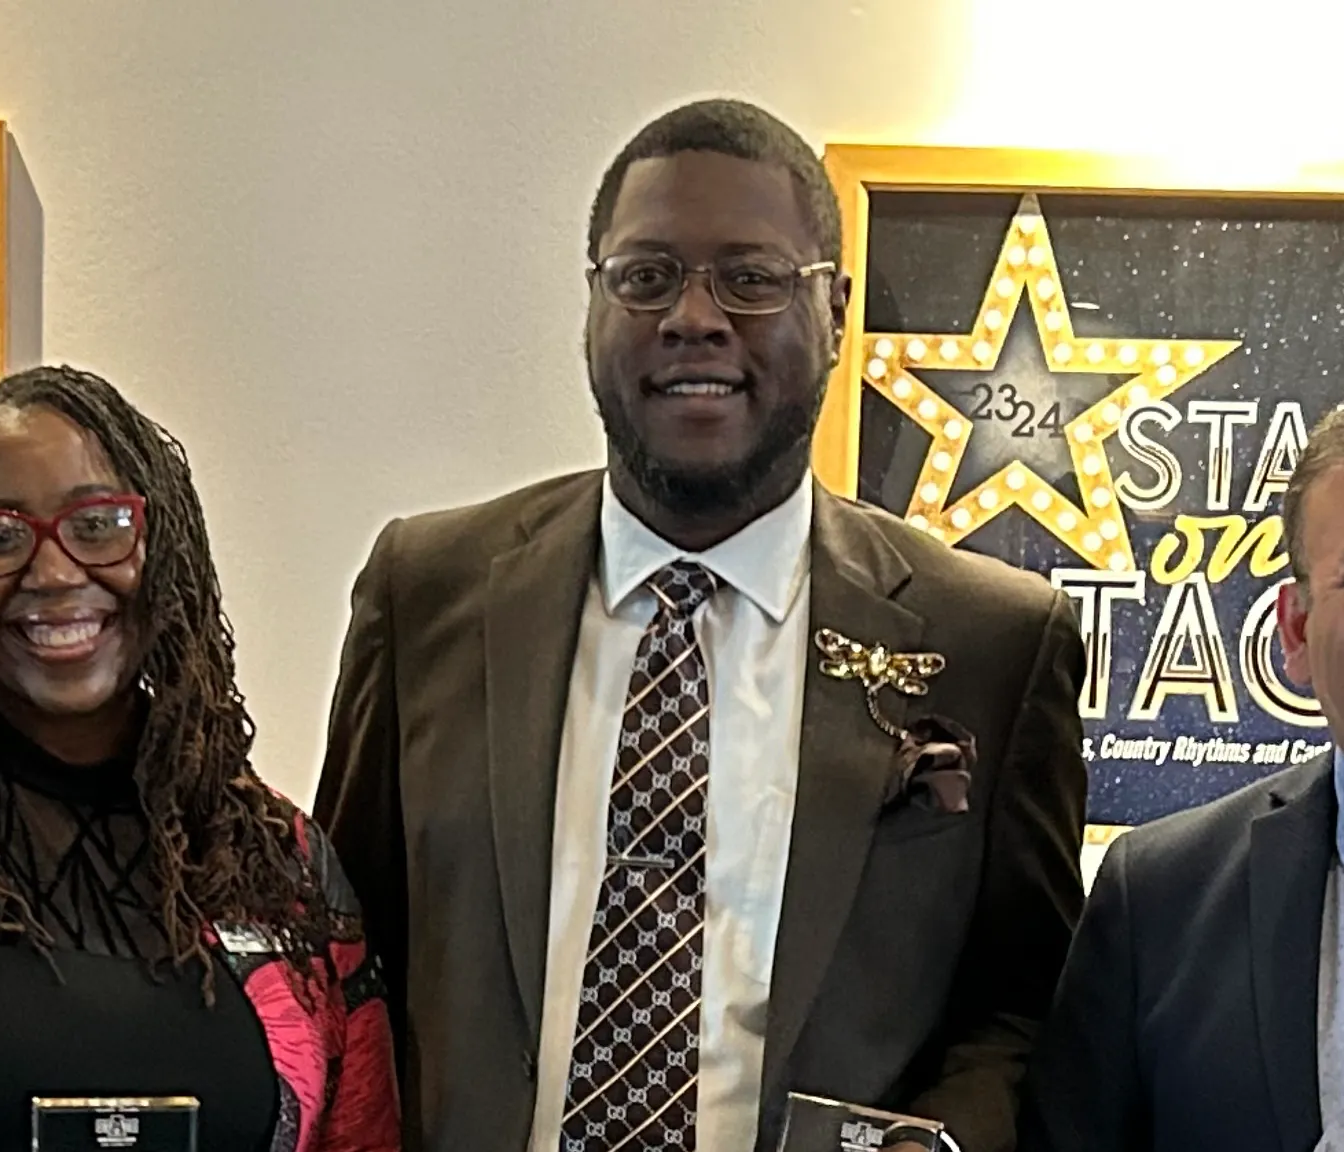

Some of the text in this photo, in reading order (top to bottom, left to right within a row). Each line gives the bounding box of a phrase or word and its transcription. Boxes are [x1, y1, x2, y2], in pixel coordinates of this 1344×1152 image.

[1115, 400, 1312, 511] STA
[1150, 514, 1291, 585] on
[1100, 733, 1172, 766] Country
[1172, 735, 1251, 767] Rhythms
[1253, 739, 1290, 764] and
